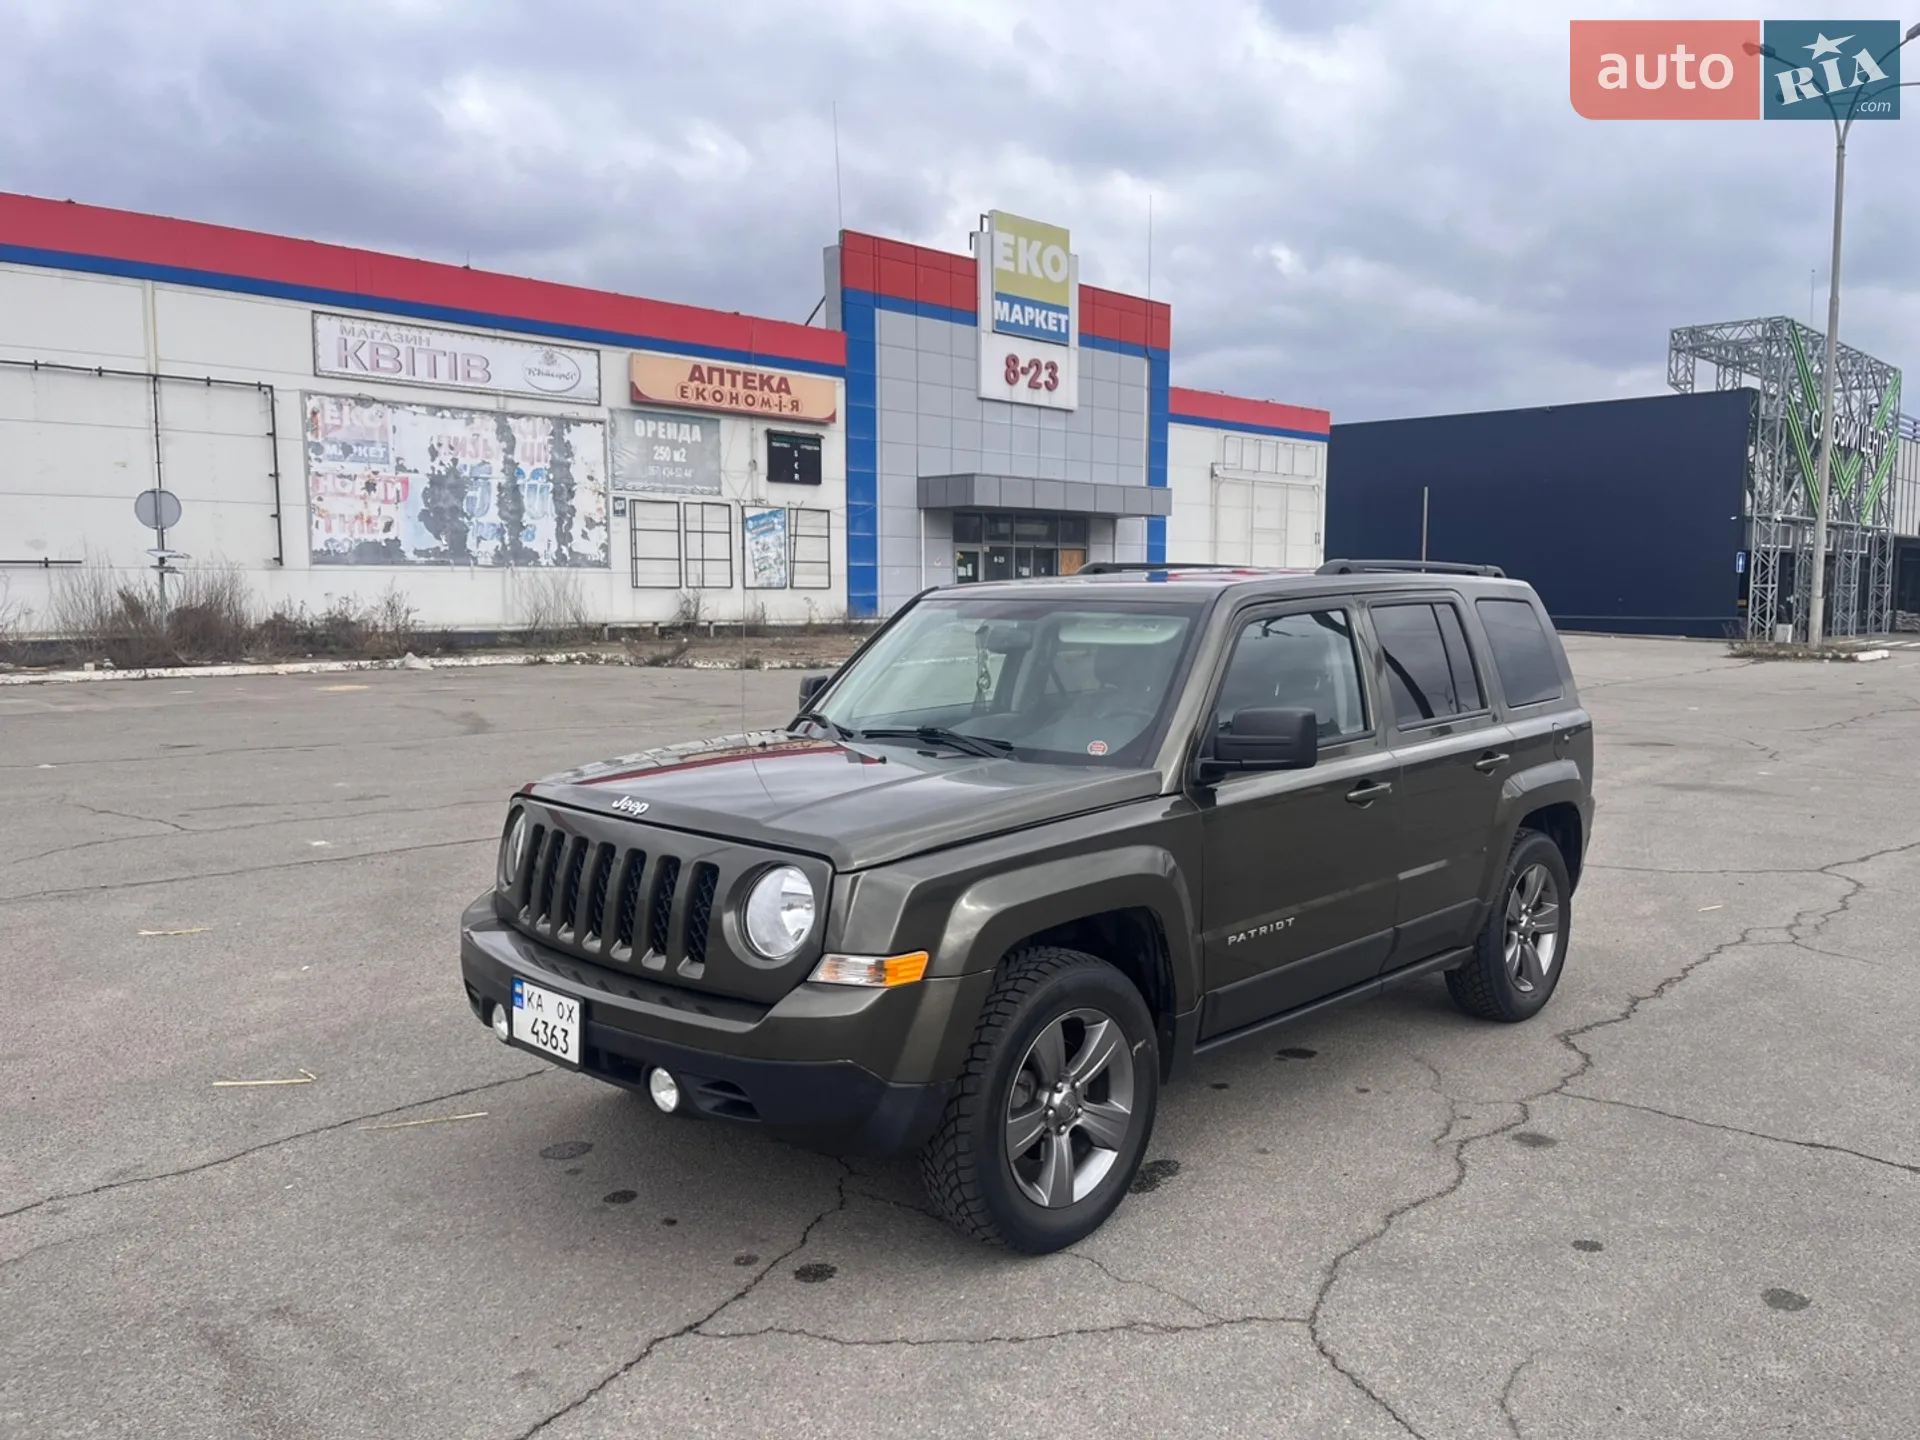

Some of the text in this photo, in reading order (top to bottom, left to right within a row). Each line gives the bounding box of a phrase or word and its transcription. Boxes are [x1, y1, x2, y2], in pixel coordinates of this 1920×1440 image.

[994, 230, 1069, 283] ЕКО
[995, 301, 1069, 334] МАРКЕТ
[339, 325, 431, 347] МАГАЗИН
[336, 337, 493, 384] КВІТІВ
[1005, 354, 1060, 391] 8-23
[687, 364, 793, 395] АПТЕКА
[635, 419, 702, 444] ОРЕНДА
[612, 796, 650, 816] Jeep
[1227, 917, 1295, 946] PATRIOT
[526, 989, 544, 1012] KA
[556, 1001, 575, 1024] OX
[530, 1017, 569, 1054] 4363
